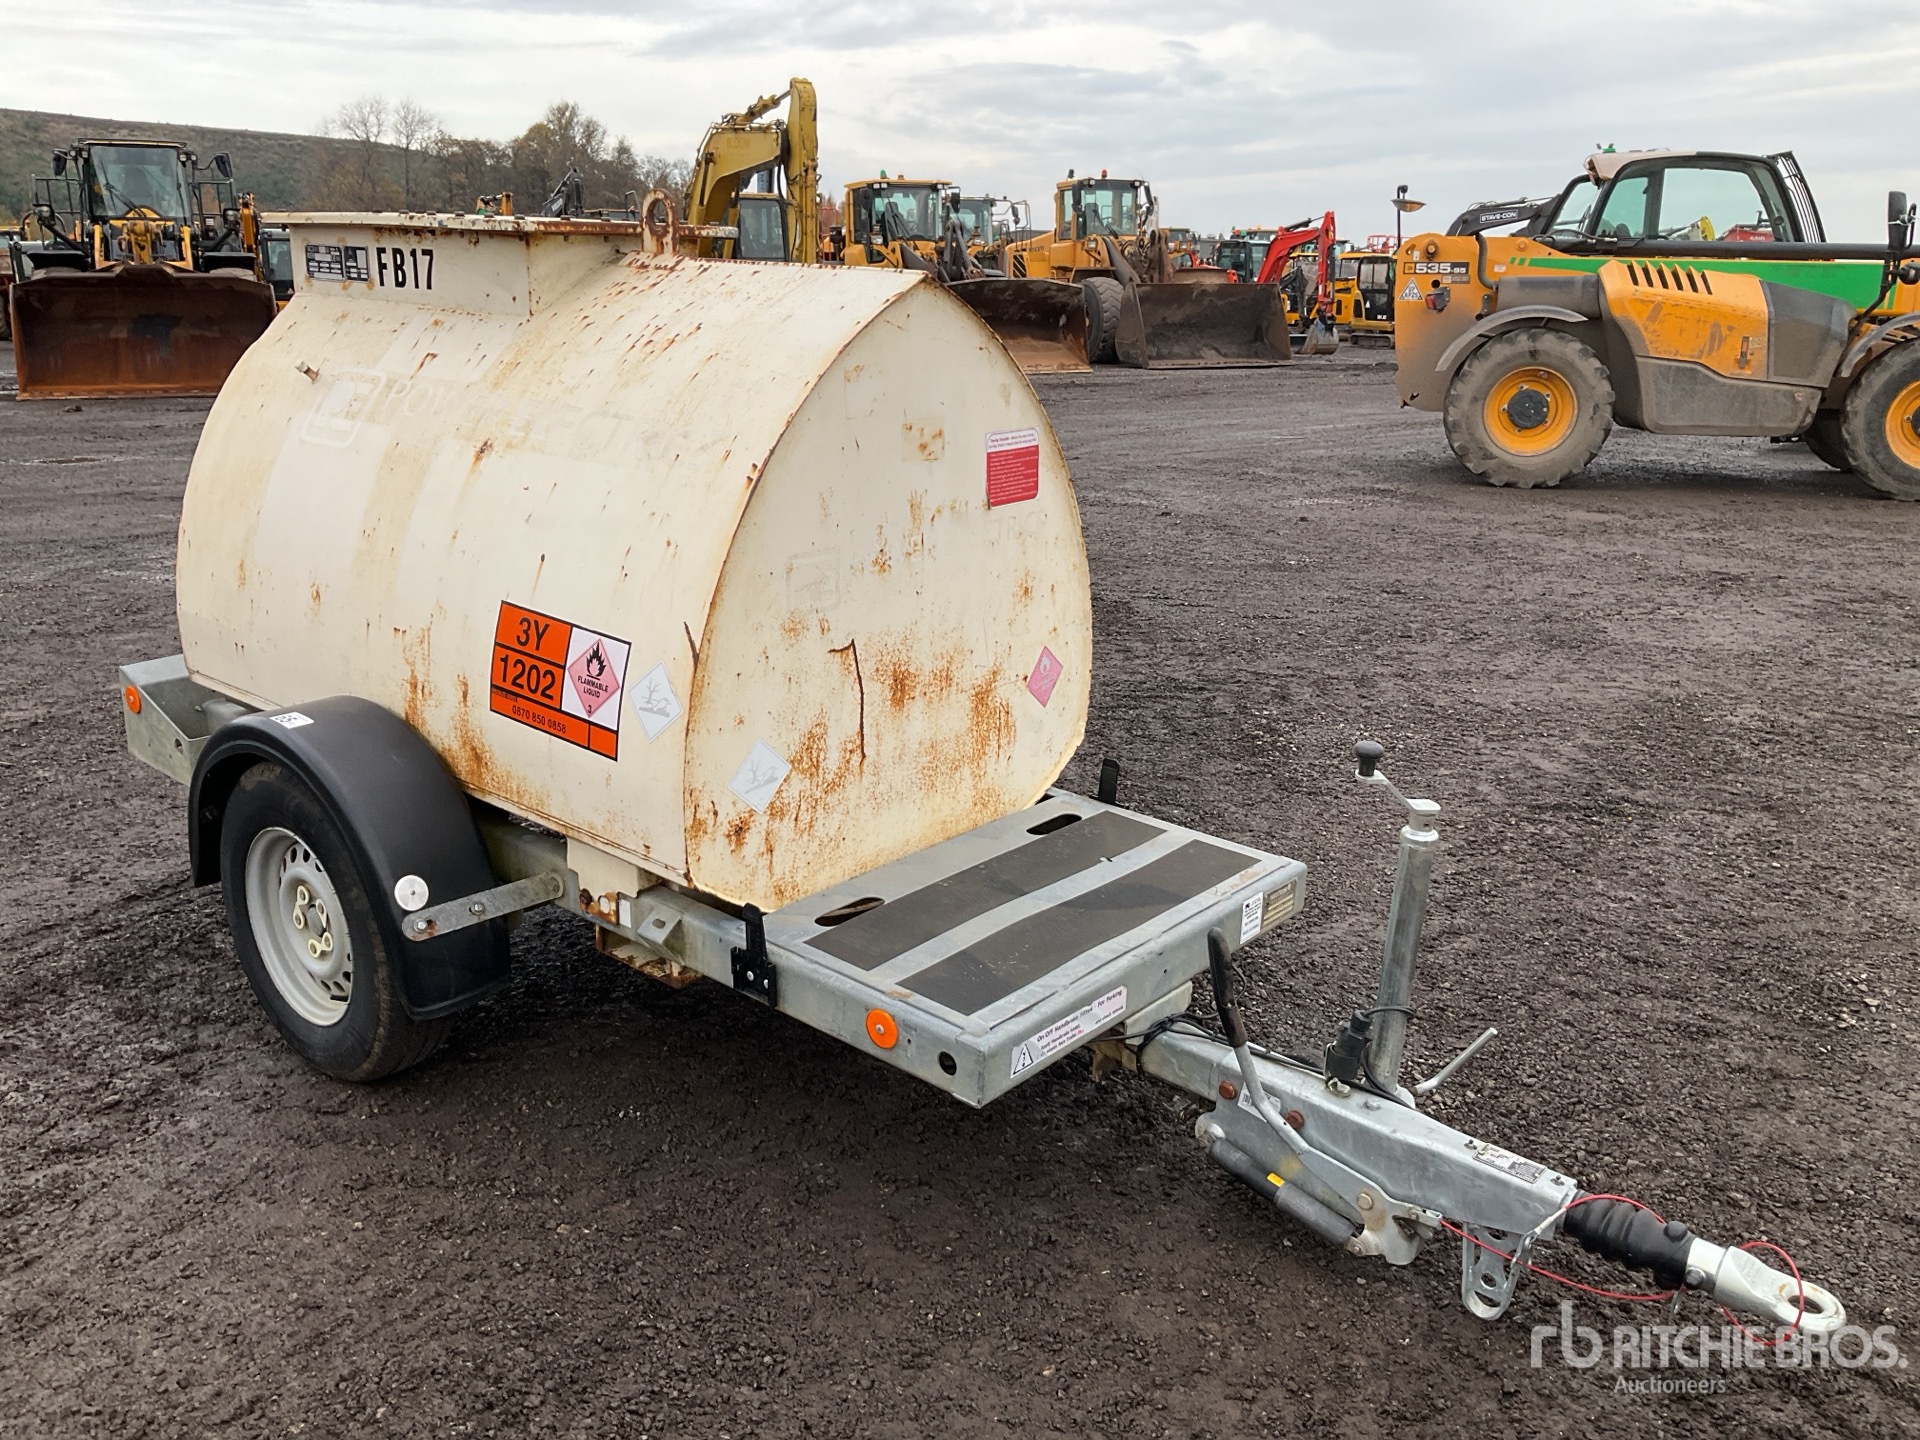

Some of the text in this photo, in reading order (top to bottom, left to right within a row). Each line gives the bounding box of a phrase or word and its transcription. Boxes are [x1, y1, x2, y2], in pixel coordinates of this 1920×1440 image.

[376, 247, 434, 290] FB17
[516, 617, 550, 651] 3Y
[500, 654, 556, 701] 1202
[577, 676, 608, 692] FLAMMABLE
[583, 686, 600, 698] LIQUID
[512, 704, 567, 734] 0870 850 0858
[1106, 990, 1122, 1004] Parking
